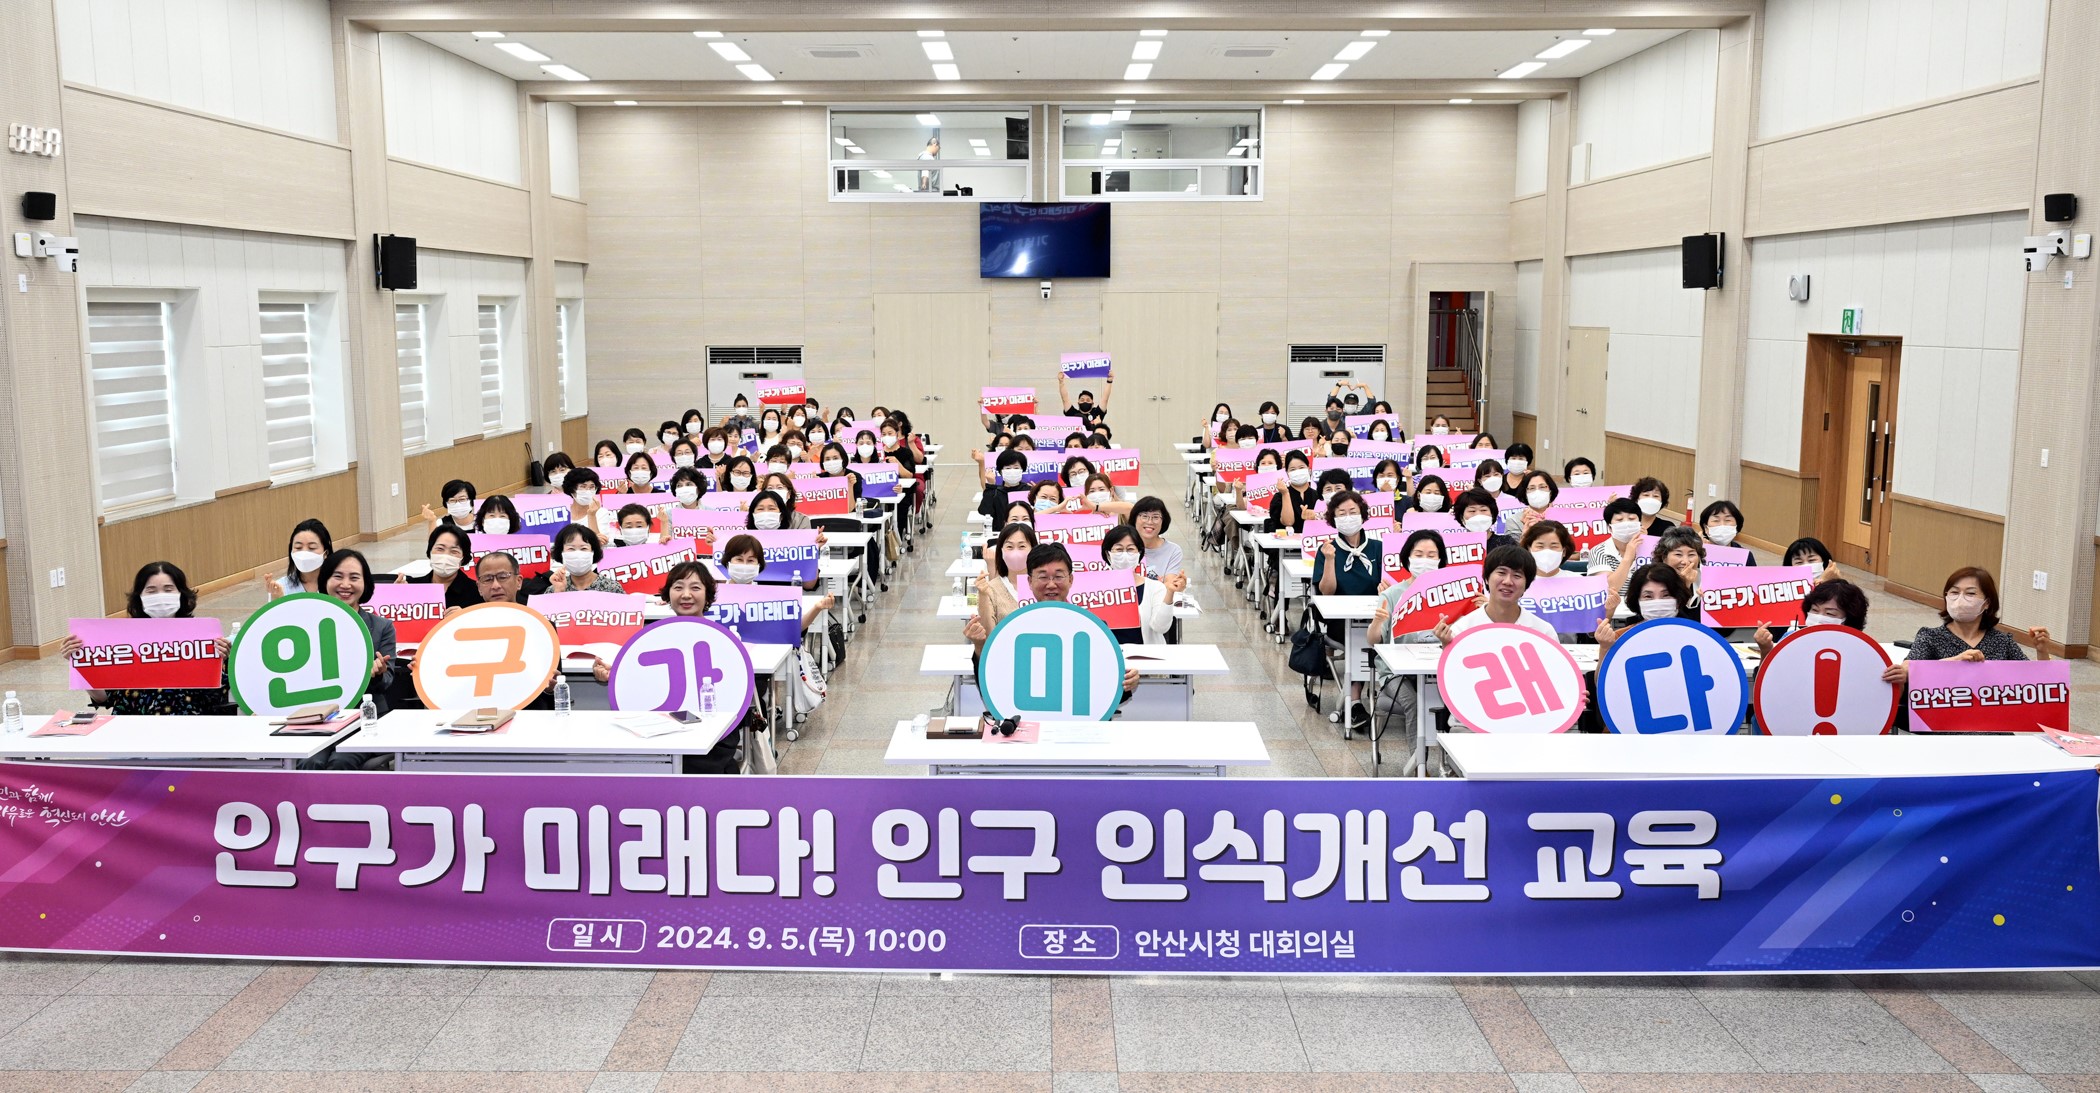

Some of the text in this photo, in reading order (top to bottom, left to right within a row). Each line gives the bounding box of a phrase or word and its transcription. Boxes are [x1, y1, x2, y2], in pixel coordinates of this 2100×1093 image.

[1062, 358, 1110, 371] 인구가 미래다
[757, 385, 804, 398] 인구가 미래다
[983, 394, 1034, 406] 인구가 미래다
[1022, 462, 1058, 475] 산이다
[1104, 457, 1139, 473] 미래다
[1217, 461, 1243, 471] 안산은
[600, 479, 629, 490] 산이다
[865, 471, 898, 485] 미래다
[805, 487, 848, 502] 안산이다
[1246, 485, 1270, 501] 안산은
[524, 505, 569, 527] 미래다
[673, 526, 708, 540] 안산은
[1035, 524, 1115, 544] 구가 미래다
[763, 545, 818, 563] 안산이다
[1071, 586, 1137, 609] 안산이다
[1425, 576, 1480, 607] 미래다
[1539, 590, 1607, 614] 안산이다
[1703, 579, 1813, 611] 인구가 미래다
[380, 601, 445, 622] 안산이다
[574, 610, 643, 627] 안산이다
[704, 599, 801, 624] 구가 미래다
[71, 638, 221, 668] 안산은 안산이다
[261, 617, 343, 708] 인
[447, 626, 526, 697] 구
[638, 641, 724, 712] 가
[1014, 631, 1091, 716] 미
[1463, 642, 1564, 720] 래
[1625, 645, 1715, 735] 다
[1909, 683, 2068, 710] 안산은 안산이다
[39, 806, 87, 828] 혁신도시
[90, 808, 131, 827] 안산
[213, 800, 1725, 902] 인구가 미래다! 인구 인식개선 교육
[657, 926, 947, 957] 2024. 9. 5.(목) 10:00
[1136, 929, 1356, 960] 안산시청 대회의실
